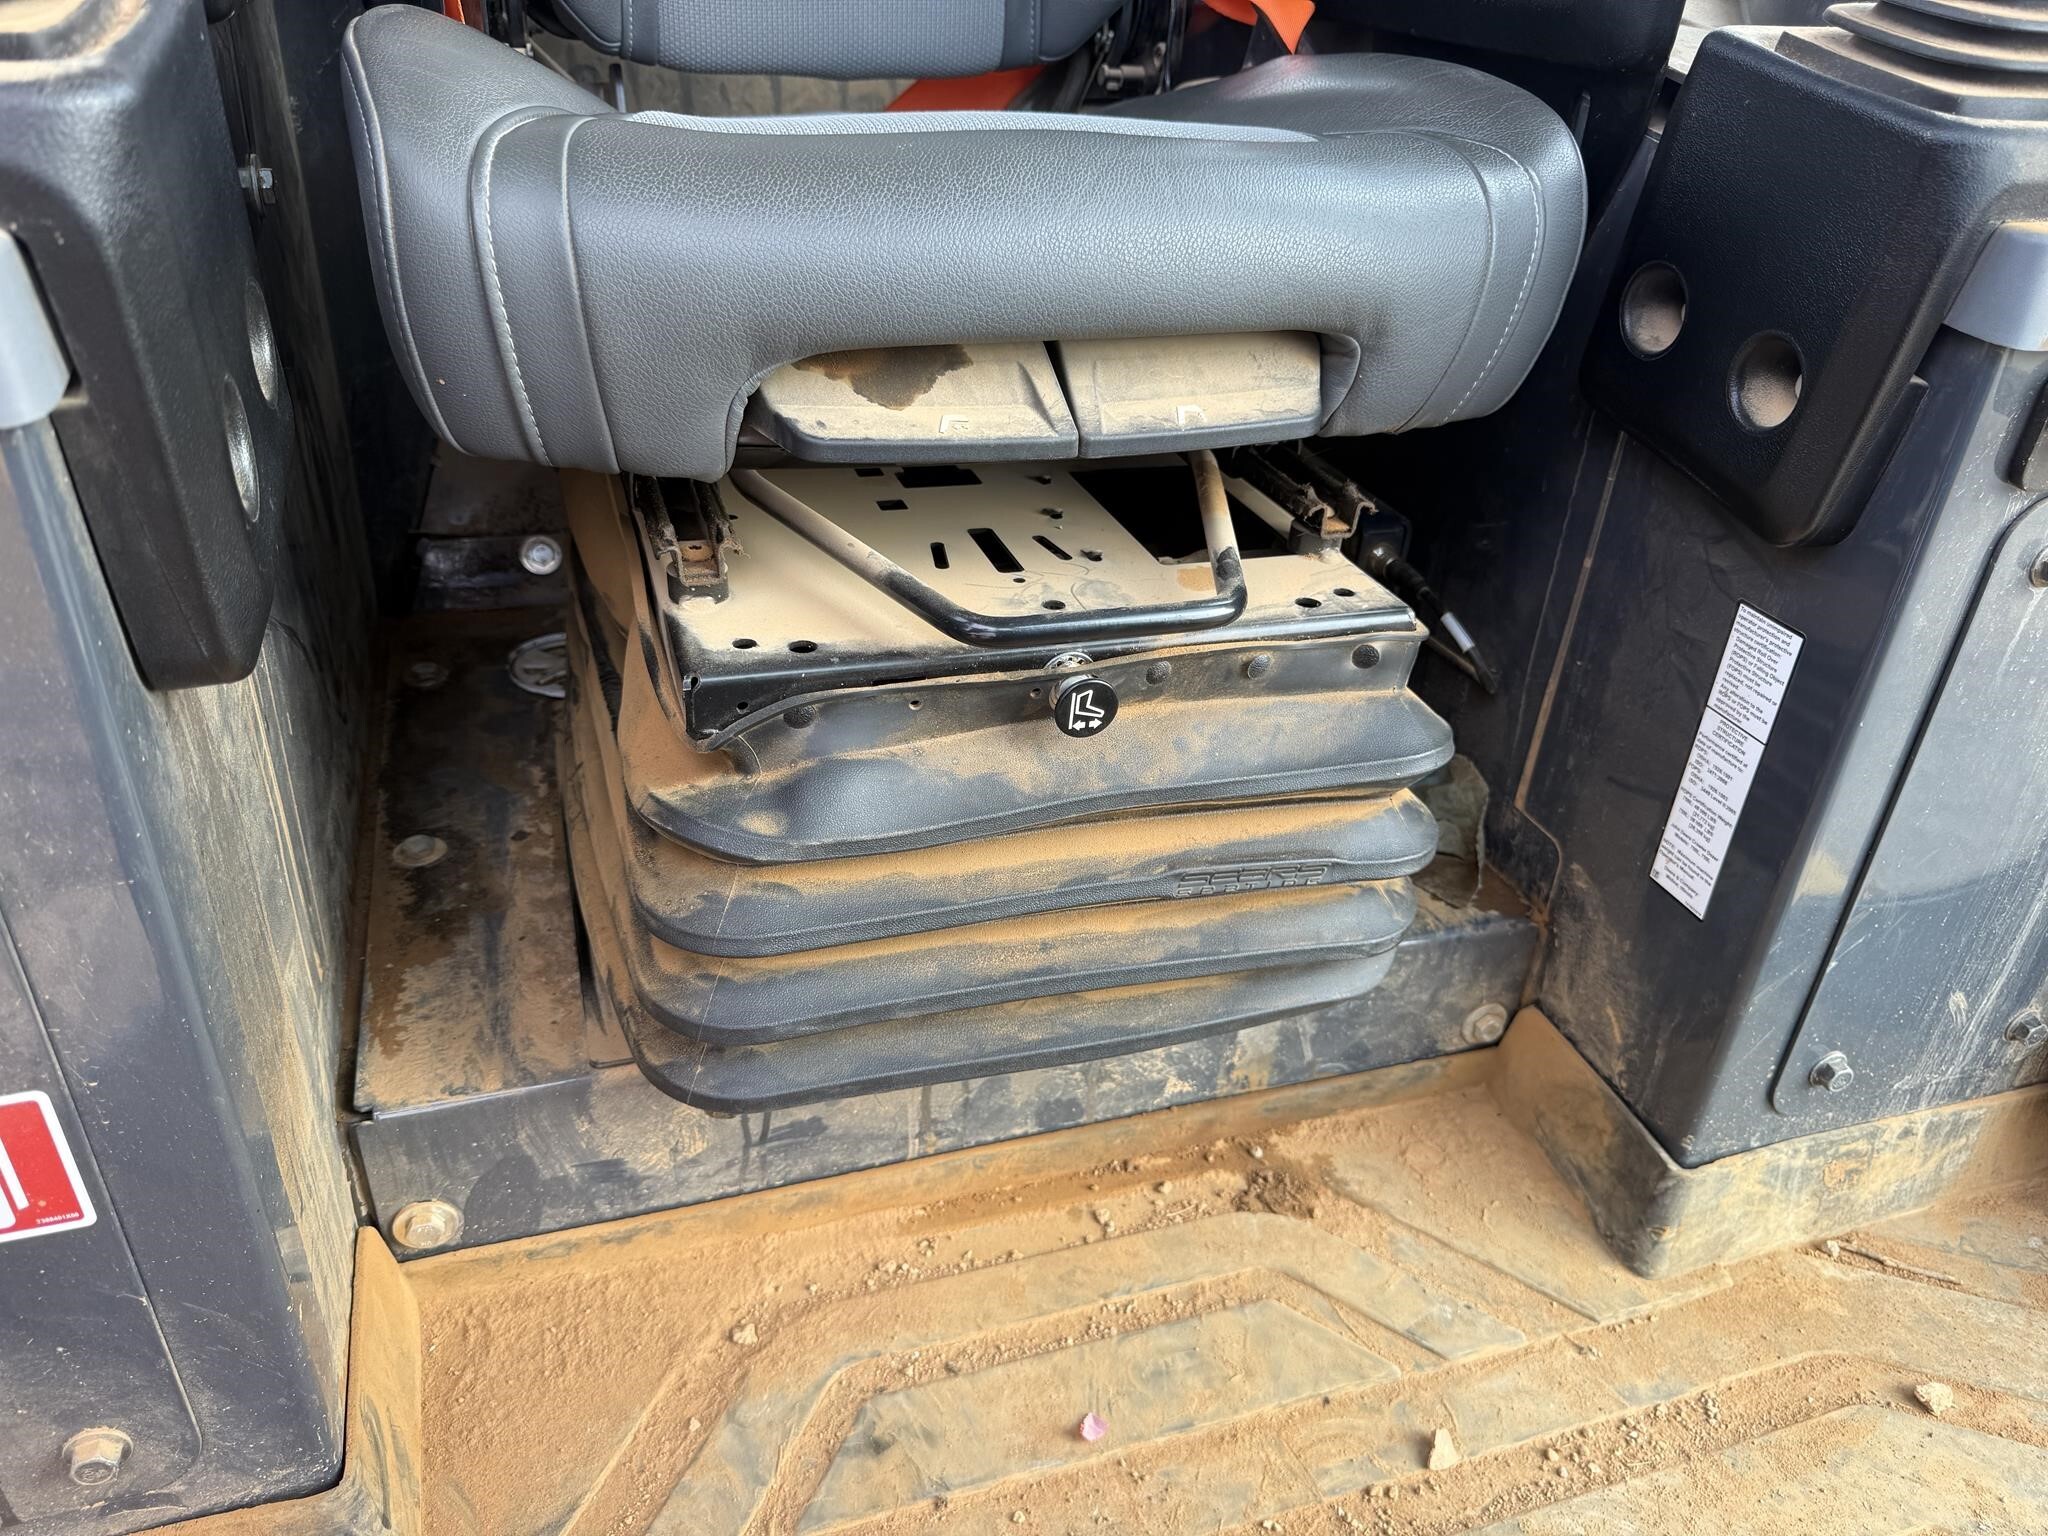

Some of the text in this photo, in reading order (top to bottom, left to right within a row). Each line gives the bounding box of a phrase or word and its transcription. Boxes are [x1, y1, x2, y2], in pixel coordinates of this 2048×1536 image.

[1737, 613, 1757, 627] operator
[1756, 624, 1780, 641] protection
[1746, 609, 1766, 624] maintain
[1733, 627, 1753, 641] structure
[1733, 643, 1777, 673] Protective Structure
[1735, 635, 1778, 665] Damaged Roll Over
[1768, 639, 1792, 657] protective
[1726, 663, 1742, 676] (FOPS)
[1742, 673, 1754, 683] must
[1728, 656, 1772, 686] Protective Structure
[1730, 649, 1747, 663] (ROPS)
[1752, 662, 1769, 677] Falling
[1768, 673, 1784, 687] Object
[1718, 689, 1731, 700] ROPS
[1736, 701, 1750, 713] FOPS
[1749, 710, 1761, 721] must
[1729, 689, 1749, 705] alteration
[1752, 687, 1771, 703] repaired
[1717, 725, 1744, 747] STRUCTURE
[1719, 719, 1747, 741] PROTECTIVE
[1712, 729, 1745, 756] CERTIFICATION
[1724, 749, 1742, 764] certified
[1710, 793, 1722, 804] Level
